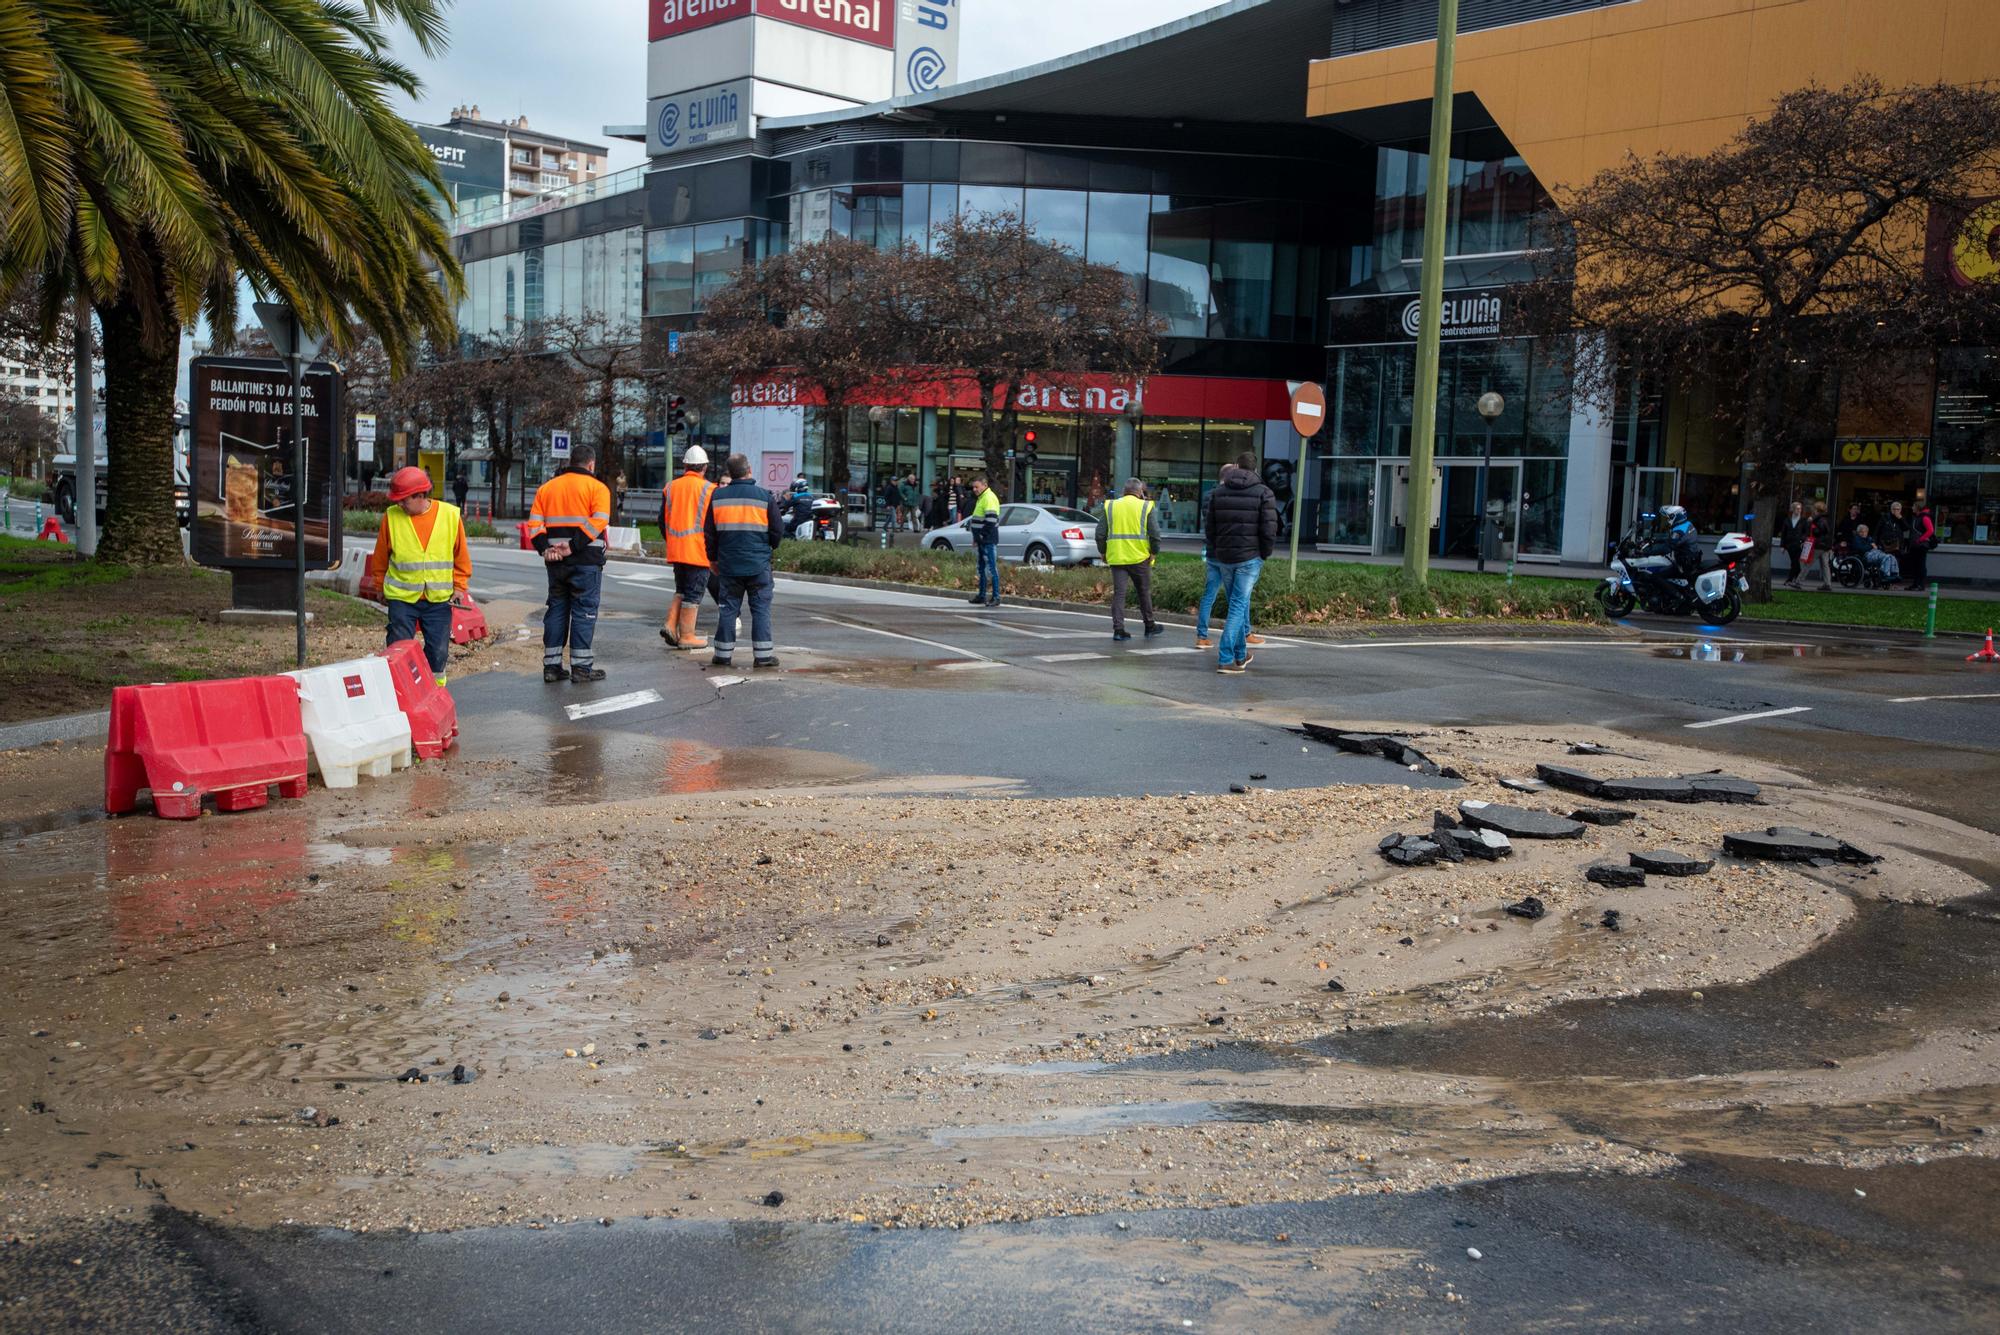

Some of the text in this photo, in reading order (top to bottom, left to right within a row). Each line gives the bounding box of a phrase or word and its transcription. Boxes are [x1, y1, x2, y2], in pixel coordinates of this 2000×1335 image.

[688, 89, 738, 129] ELVIÑA
[1441, 293, 1502, 325] ELVIÑA
[1440, 323, 1500, 336] centrocomercial
[210, 379, 314, 399] BALLANTINE'S 10 AOS.
[210, 396, 319, 417] PERDÓN POR LA ESERA.
[1842, 442, 1924, 462] GADIS
